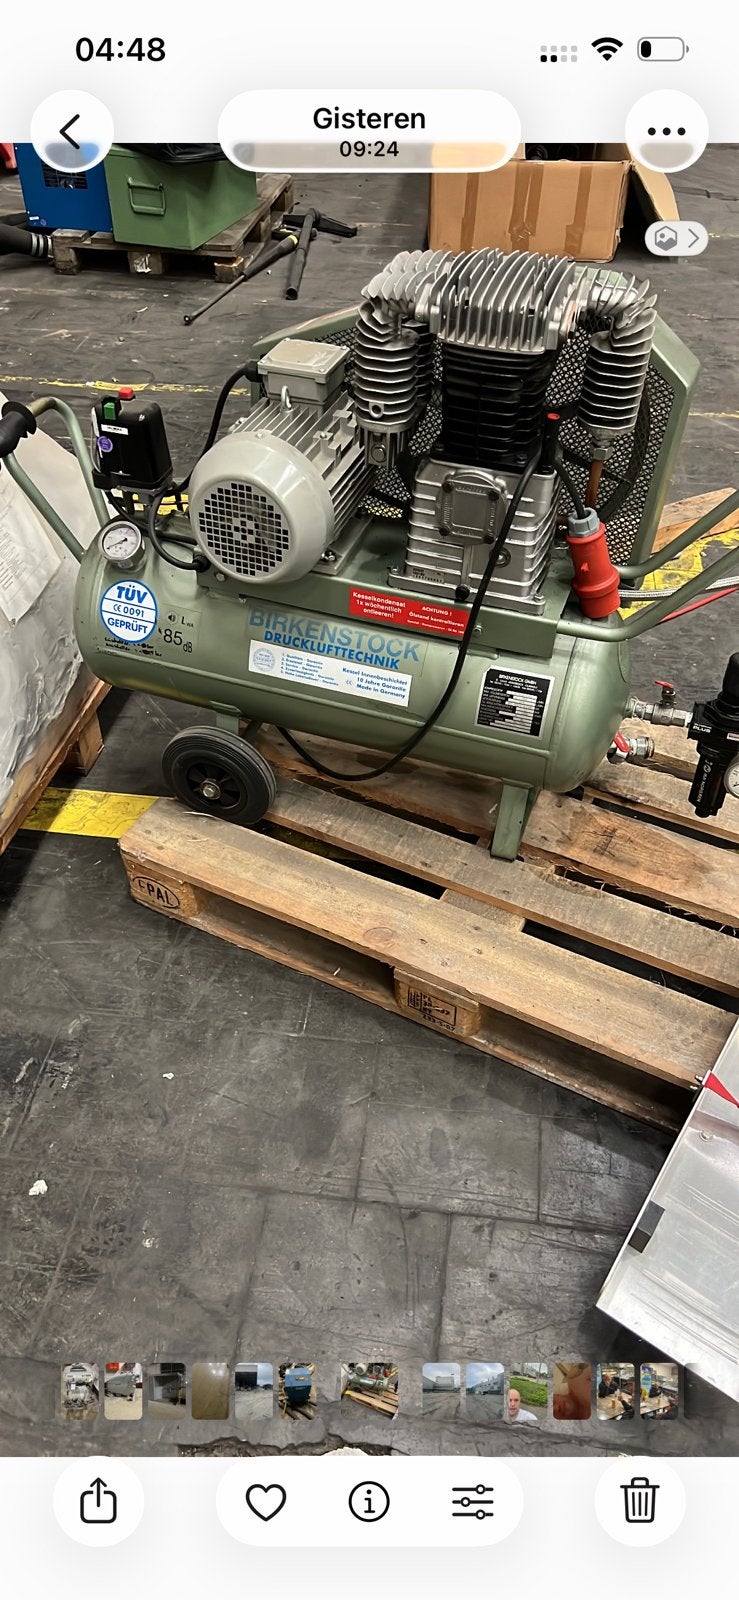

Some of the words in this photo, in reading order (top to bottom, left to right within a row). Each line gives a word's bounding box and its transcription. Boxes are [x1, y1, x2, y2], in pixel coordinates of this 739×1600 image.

[117, 585, 148, 603] TÜV
[123, 605, 145, 618] 0091
[363, 608, 394, 618] entleeren!
[365, 600, 402, 613] wöchentlich
[422, 606, 449, 616] ACHTUNG
[107, 616, 148, 634] GEPRÜFT
[163, 628, 183, 646] 85
[183, 641, 193, 654] dB
[249, 608, 421, 662] BIRKENSTOCK
[264, 630, 400, 670] DRUCKLUFTTECHNIK
[342, 667, 360, 676] Kessel
[356, 683, 372, 691] Made
[379, 688, 406, 699] Germany
[364, 678, 380, 686] Jahre
[381, 682, 406, 692] Garantie
[692, 725, 711, 733] PLUS
